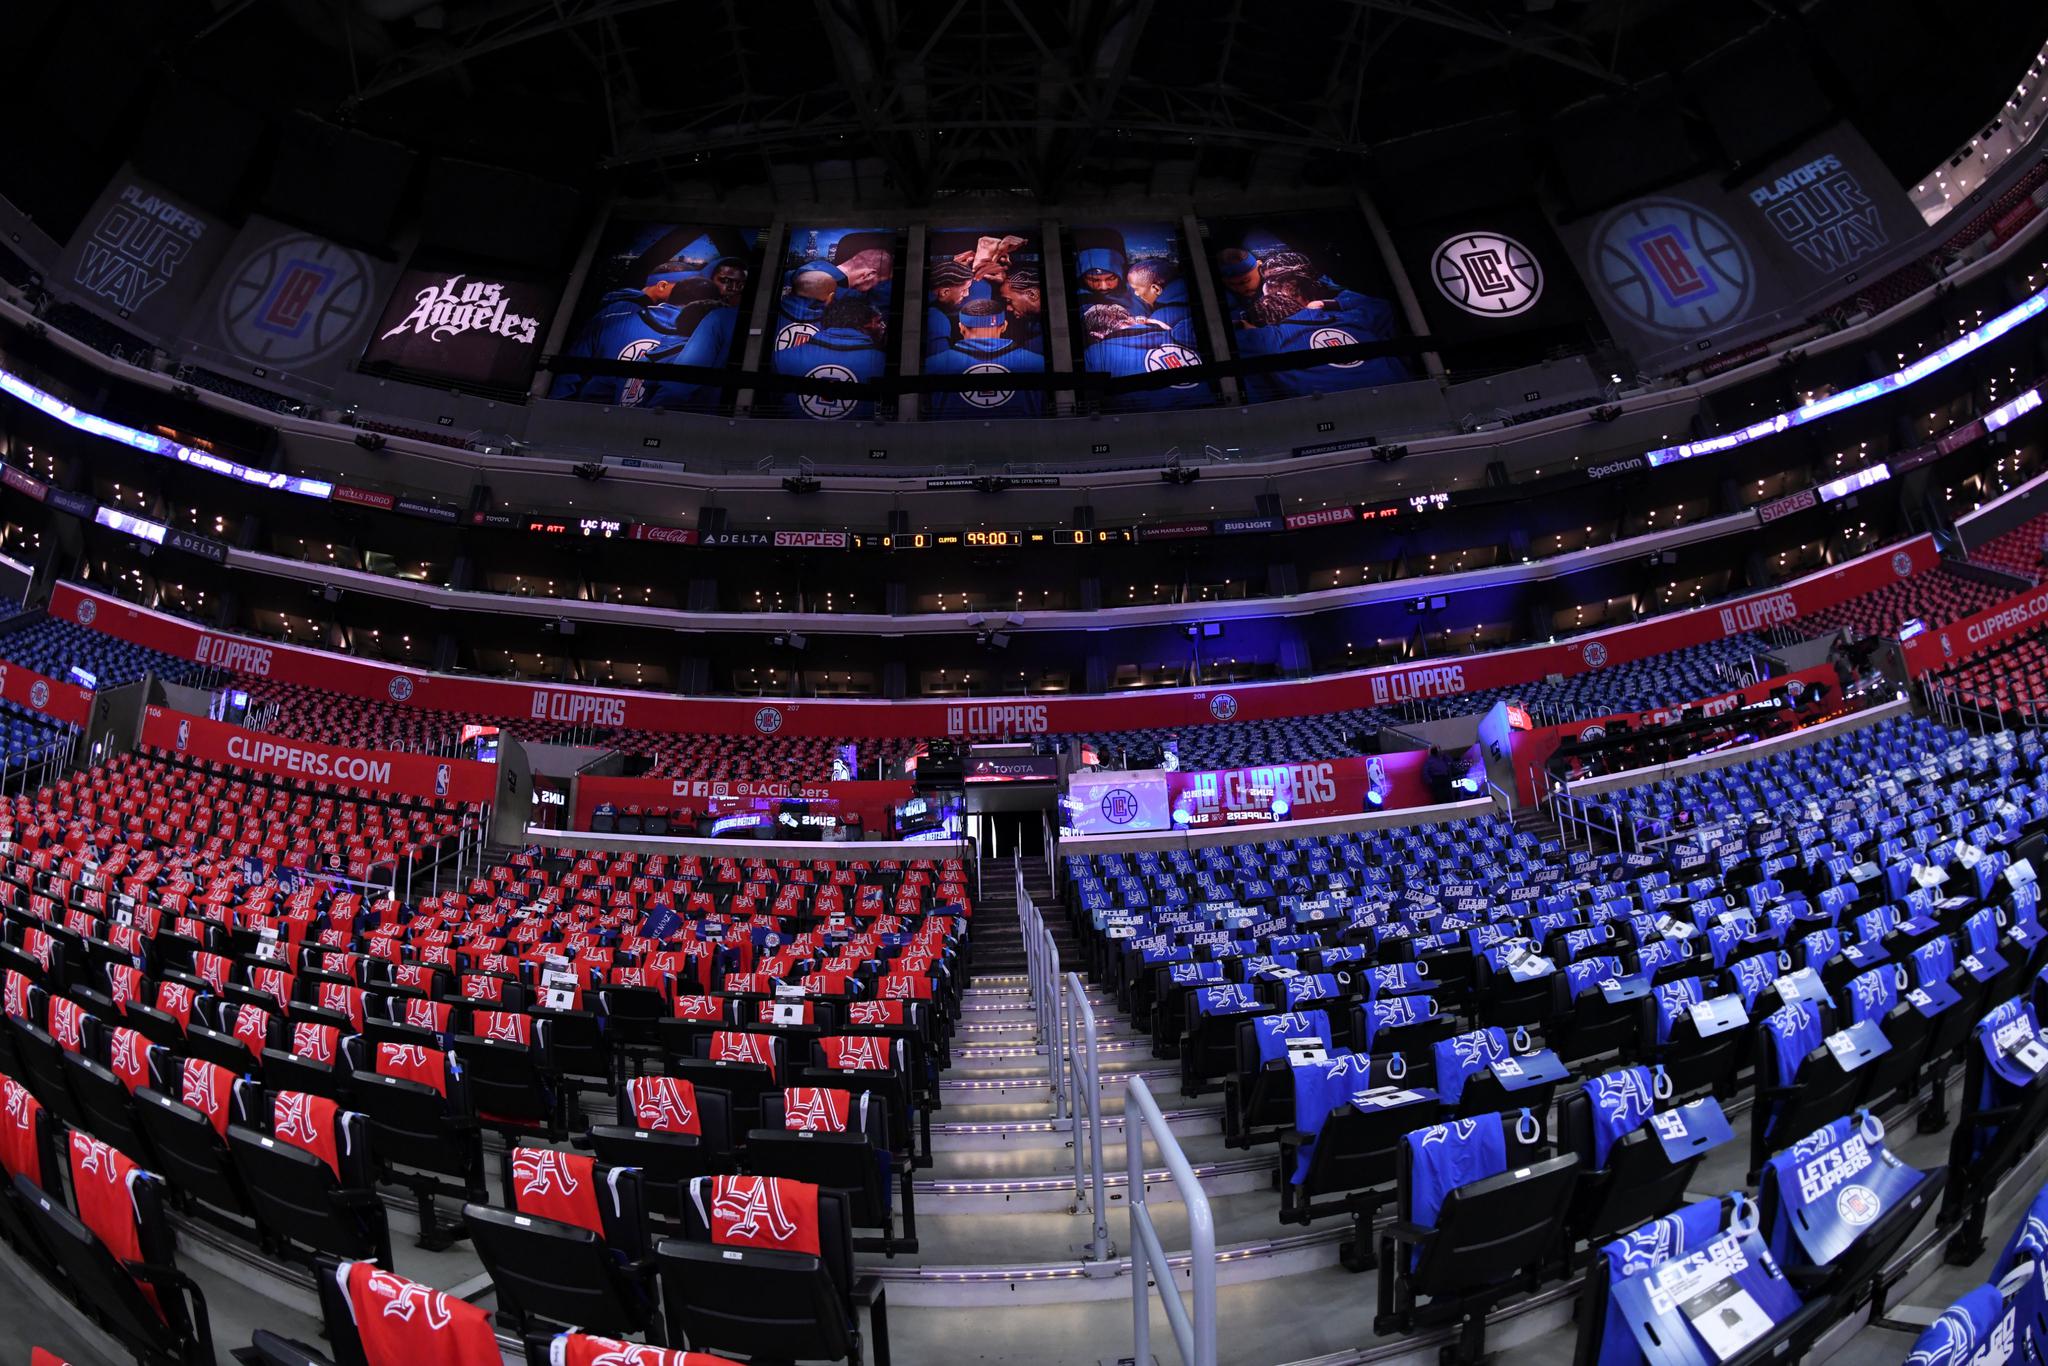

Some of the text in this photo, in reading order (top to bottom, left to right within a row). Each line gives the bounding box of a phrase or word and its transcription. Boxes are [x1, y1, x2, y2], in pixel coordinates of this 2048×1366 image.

[1750, 153, 1842, 207] PLAYOFFS
[120, 185, 206, 240] PLAYOFFS
[1765, 171, 1871, 241] OUR
[94, 204, 192, 277] OUR
[1792, 205, 1889, 273] WAY
[74, 241, 166, 312] WAY
[440, 274, 505, 307] Los
[381, 287, 540, 344] Angeles
[1588, 456, 1642, 479] Spectrum
[339, 487, 363, 499] WELLS
[364, 493, 390, 505] FARGO
[400, 502, 456, 518] AMERICAN EXPRESS
[1410, 493, 1448, 506] LAC PHX
[1762, 493, 1814, 521] STAPLES
[486, 515, 509, 523] TOYOTA
[530, 523, 565, 533] FT ATT
[580, 519, 620, 531] LAC PHX
[1225, 521, 1272, 530] BUD LIGHT
[1287, 508, 1353, 527] TOSHIBA
[584, 528, 612, 538] 0 0
[720, 534, 767, 544] DELTA
[776, 532, 843, 546] STAPLES
[884, 537, 890, 546] 0
[915, 534, 924, 547] 0
[967, 532, 1007, 545] 99:00
[1074, 531, 1084, 543] 0
[1100, 532, 1106, 541] 0
[184, 538, 221, 558] DELTA
[1719, 592, 1798, 635] LA CLIPPERS
[1967, 595, 2048, 643] CLIPPERS.CO
[195, 635, 273, 675] LA CLIPPERS
[80, 690, 92, 701] 105
[1371, 665, 1465, 704] LA CLIPPERS
[149, 707, 162, 718] 106
[532, 691, 626, 726] LA CLIPPERS
[948, 705, 1048, 735] LA CLIPPERS
[227, 736, 391, 785] CLIPPERS.COM
[994, 765, 1034, 773] TOYOTA
[737, 782, 829, 798] @LACliers
[1194, 762, 1337, 812] LA CLIPPERS
[488, 1011, 524, 1044] LA
[720, 1031, 767, 1065] LA
[839, 1036, 889, 1070] LA
[637, 1076, 692, 1130] LA
[784, 1087, 847, 1133] LA
[1797, 1133, 1866, 1187] LET'S GO
[1801, 1149, 1873, 1204] CLIPPERS
[714, 1175, 797, 1241] LA
[1707, 1234, 1741, 1263] GO
